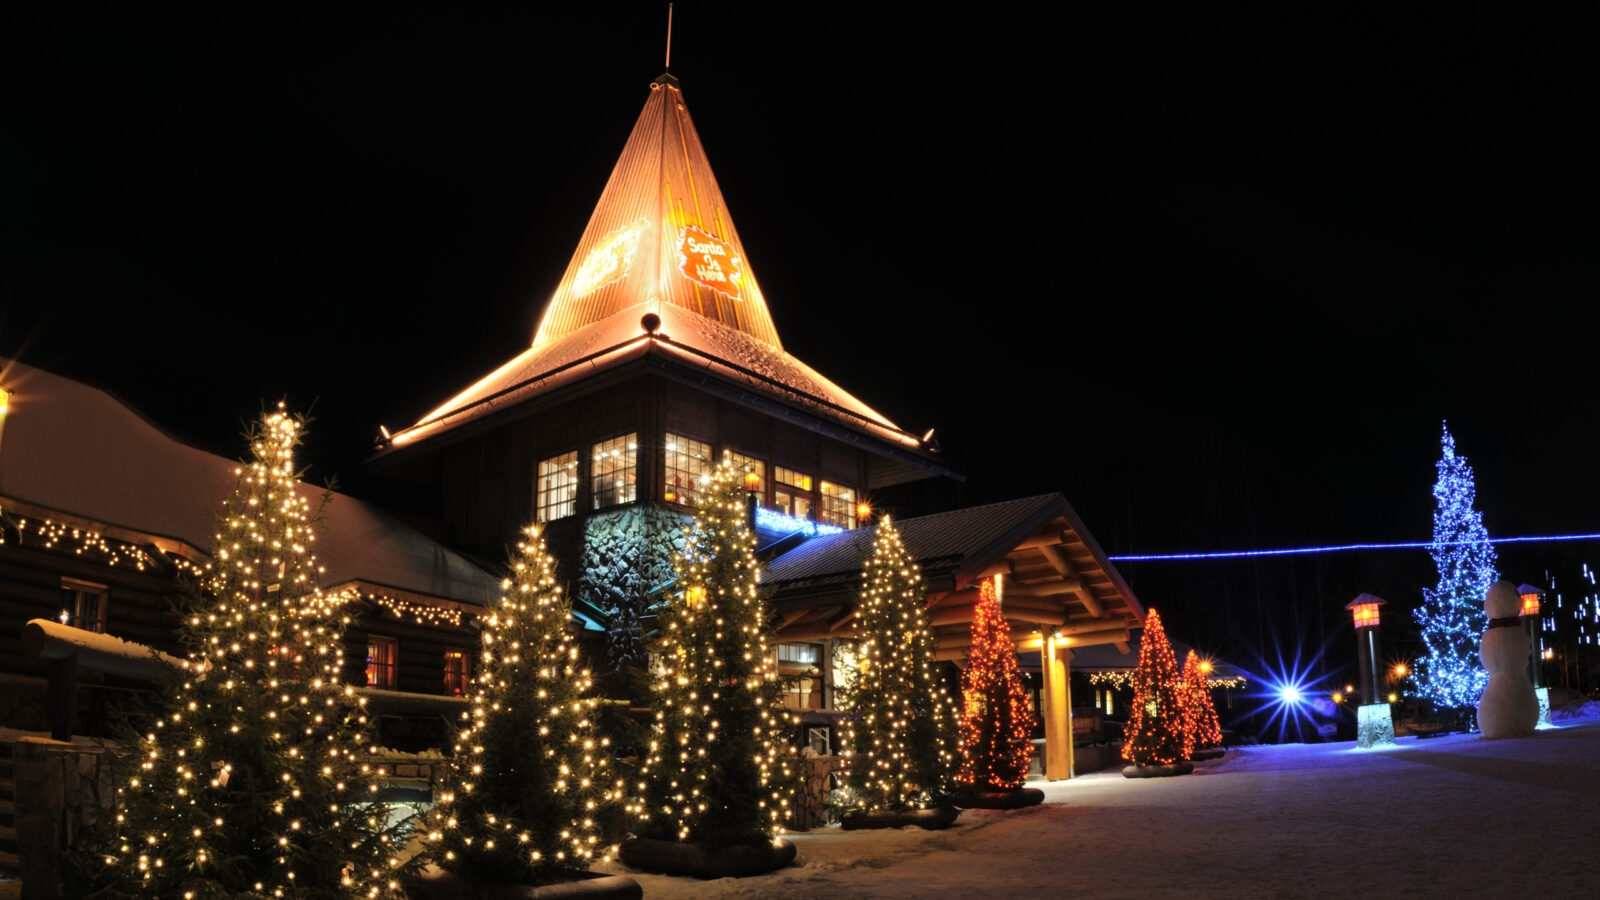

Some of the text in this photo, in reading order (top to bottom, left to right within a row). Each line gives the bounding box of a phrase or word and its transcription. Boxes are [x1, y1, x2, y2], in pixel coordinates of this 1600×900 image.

[687, 237, 726, 256] Santa
[703, 254, 721, 271] Is
[695, 264, 727, 282] Here
